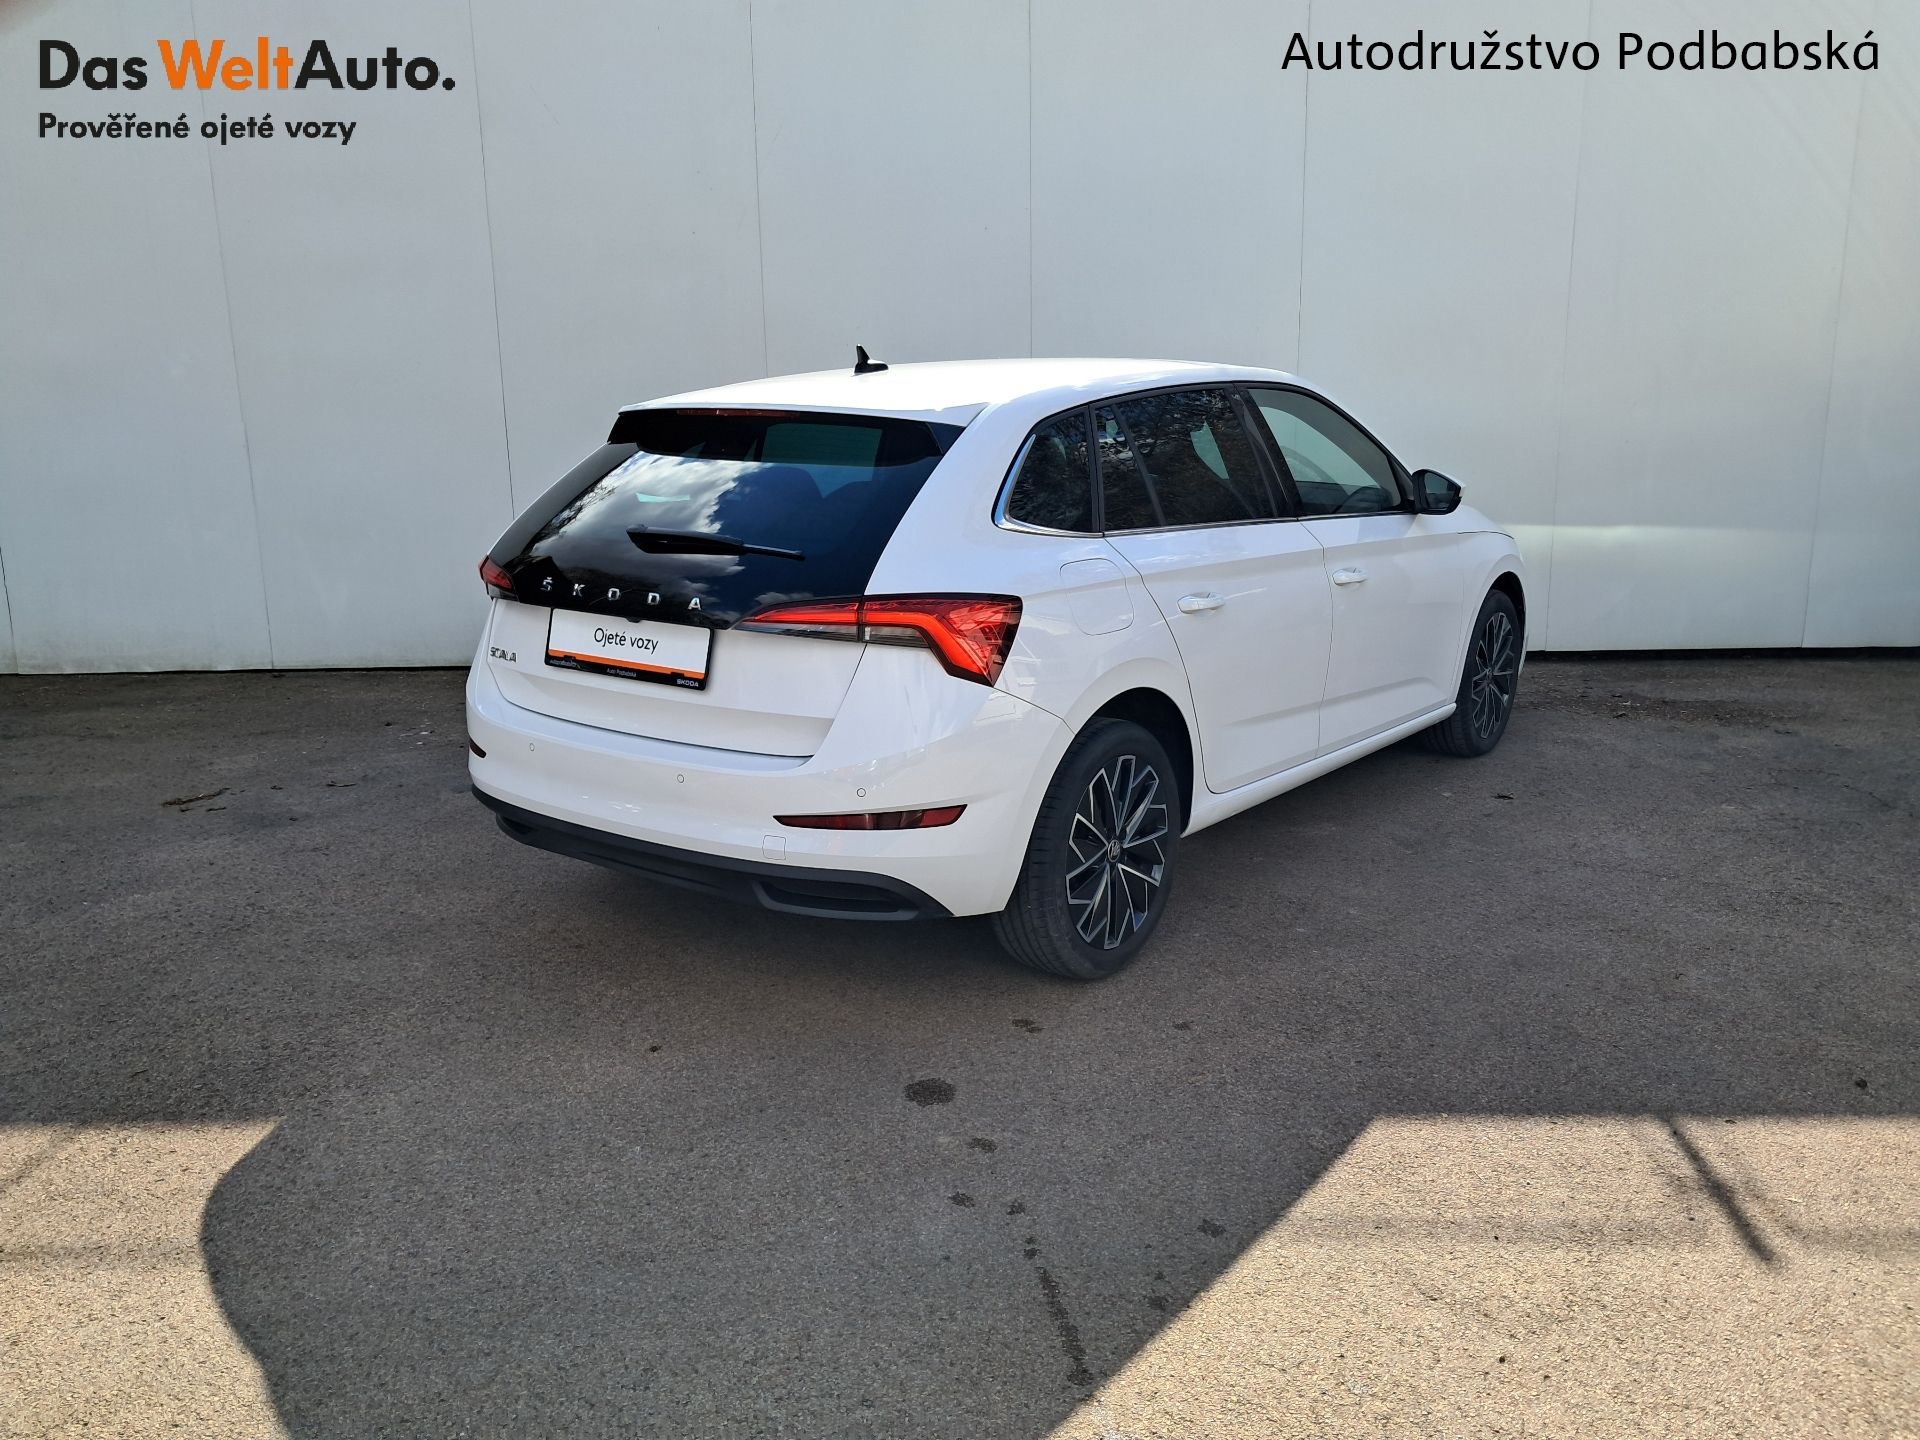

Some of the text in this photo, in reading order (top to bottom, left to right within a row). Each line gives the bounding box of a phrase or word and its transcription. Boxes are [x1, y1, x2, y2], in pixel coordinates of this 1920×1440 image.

[541, 576, 702, 611] ŠKODA
[593, 627, 659, 655] Ojeté vozy
